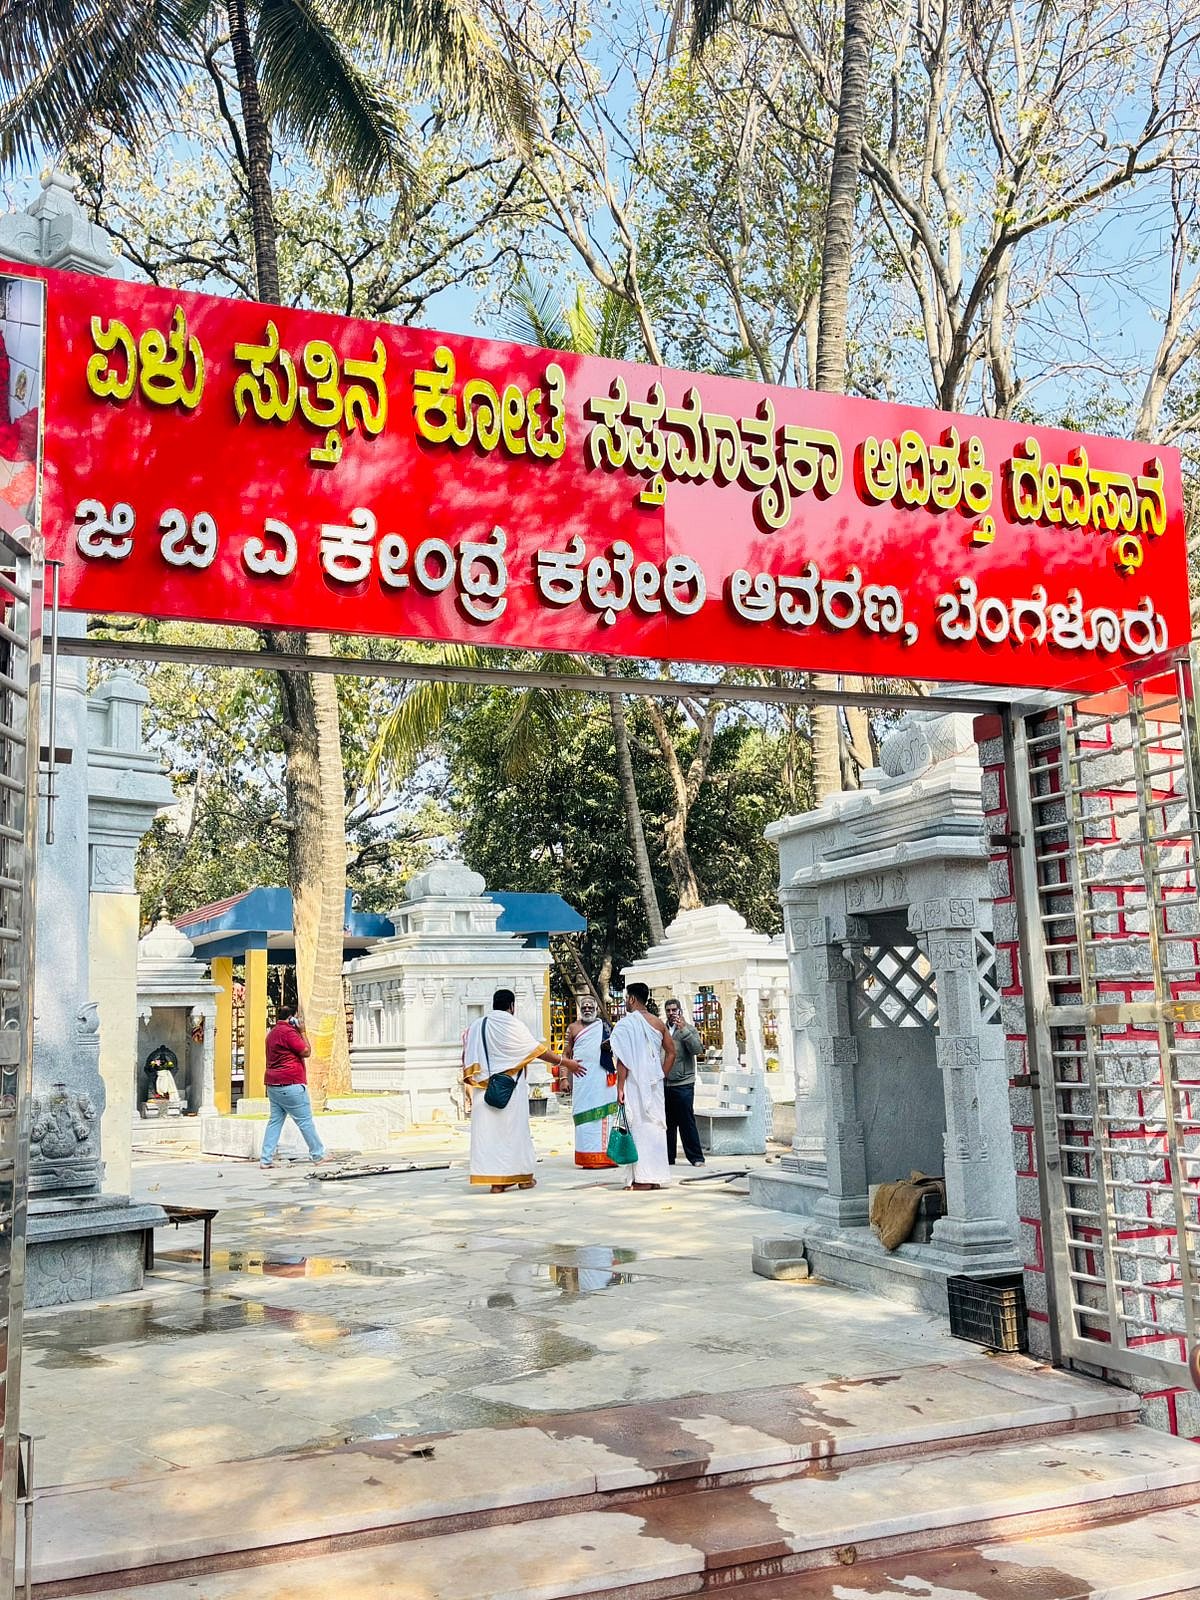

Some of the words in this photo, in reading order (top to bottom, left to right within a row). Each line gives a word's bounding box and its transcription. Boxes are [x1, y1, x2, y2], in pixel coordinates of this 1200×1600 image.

[87, 304, 205, 409] ಏಳು
[234, 319, 388, 463] ಸುತ್ತಿನ
[413, 342, 567, 459] ಕೋಟೆ
[588, 375, 843, 529] ಸಪ್ತಮಾತೃಕಾ
[862, 425, 996, 544] ಆದಿಶಕ್ತಿ
[75, 498, 136, 560] ಜಿ
[160, 507, 218, 568] ಬಿ
[243, 517, 298, 576] ಎ
[320, 507, 508, 621] ಕೇಂದ್ರ
[537, 534, 706, 625] ಕಛೇರಿ
[731, 560, 919, 646] ಆವರಣ,
[939, 576, 1169, 655] ಬೆಂಗಳೂರು
